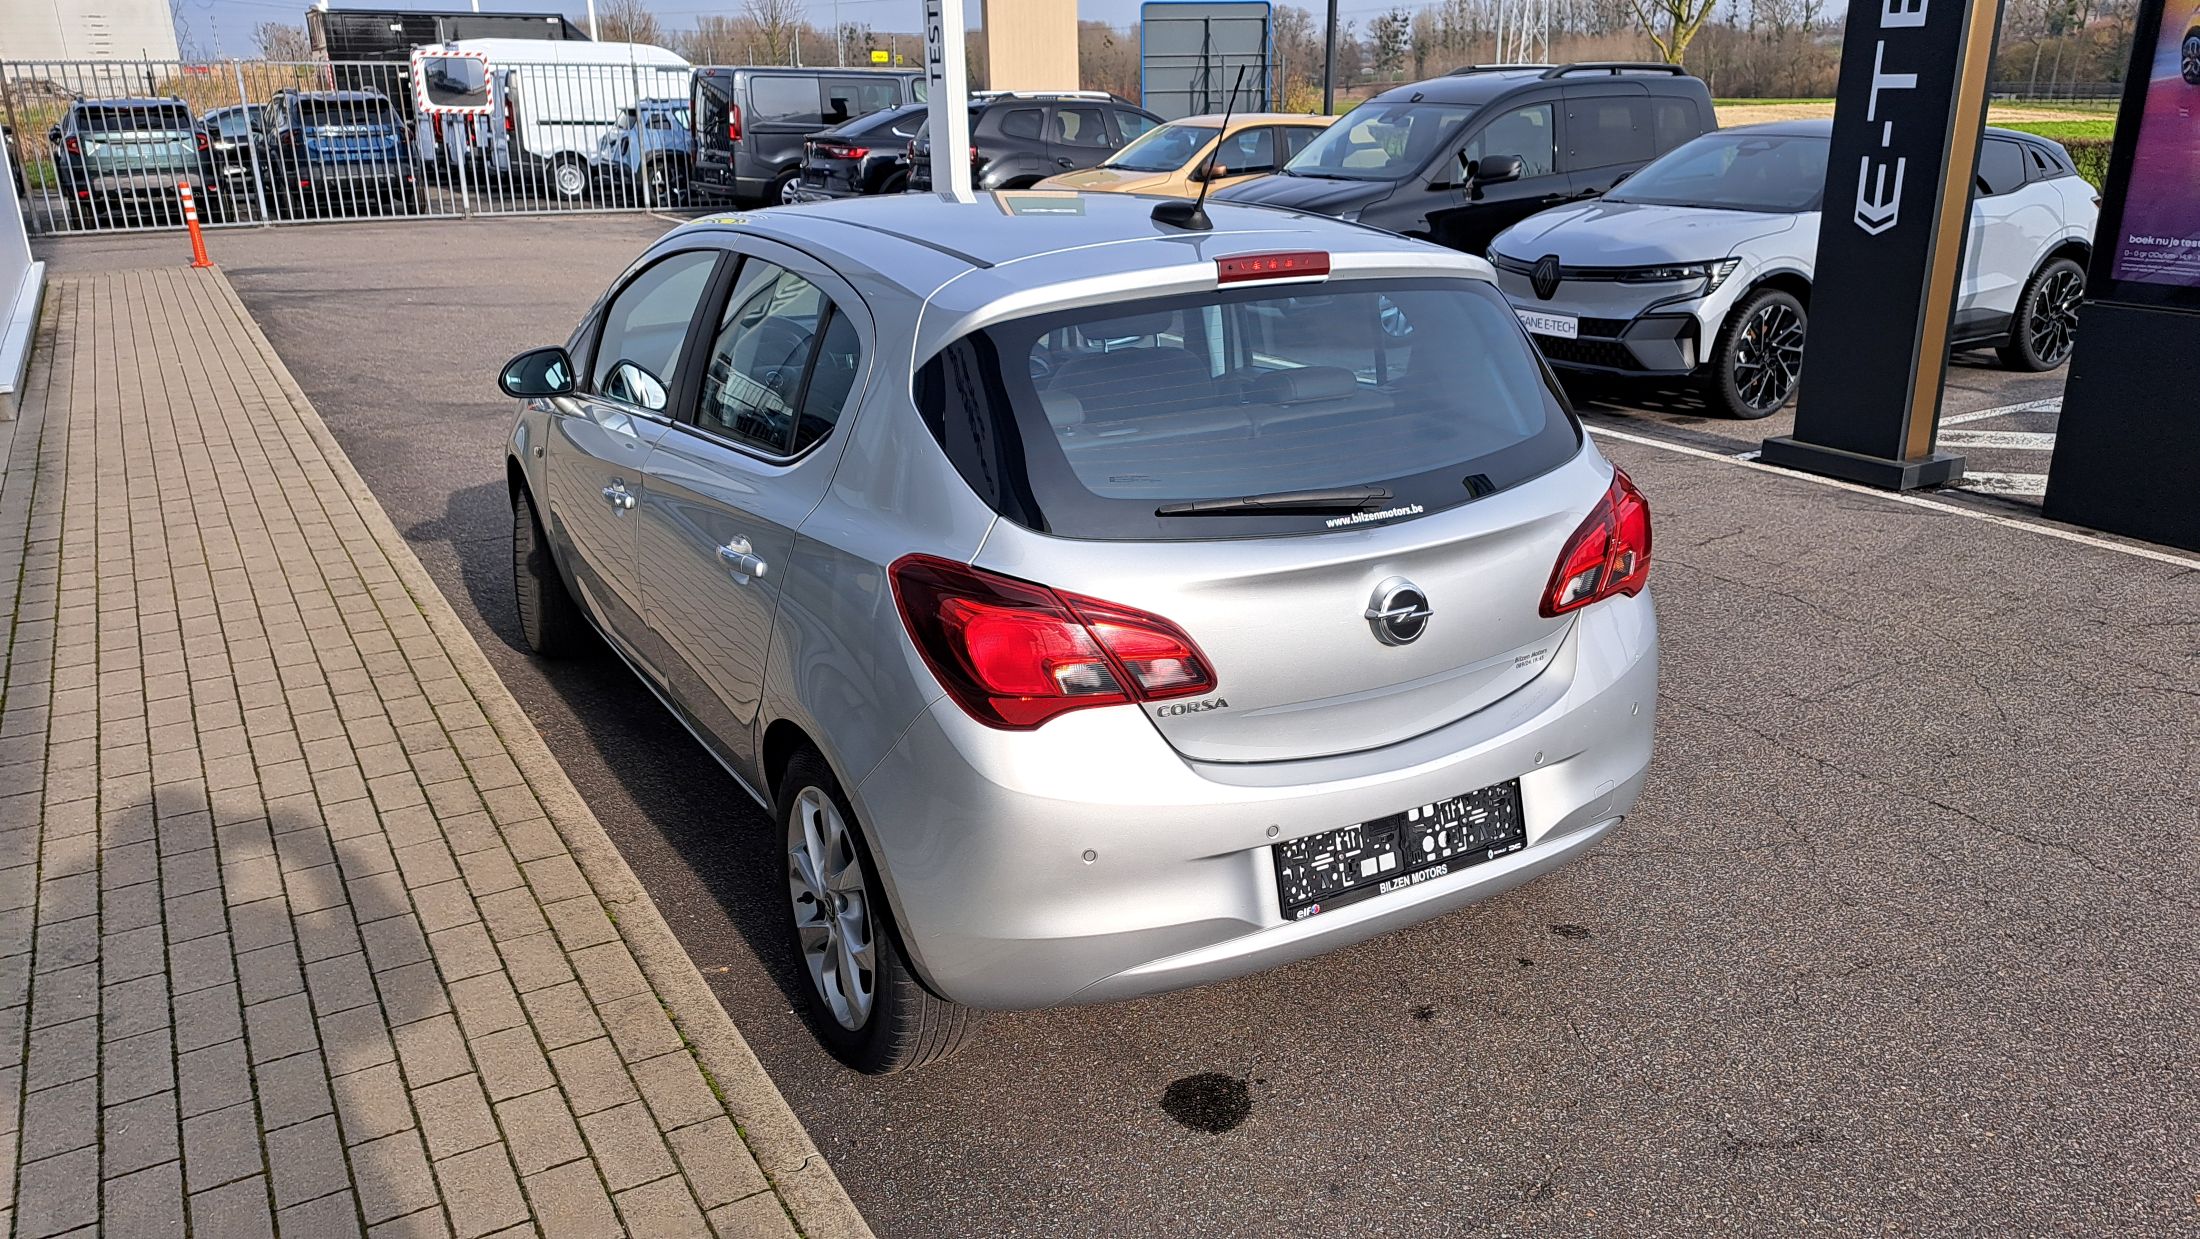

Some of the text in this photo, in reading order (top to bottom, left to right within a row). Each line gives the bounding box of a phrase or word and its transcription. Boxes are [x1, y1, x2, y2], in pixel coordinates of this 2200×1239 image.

[927, 0, 942, 87] TEST
[2129, 235, 2154, 244] boek
[2168, 236, 2180, 248] je
[1520, 314, 1576, 333] GANE E-TECH
[1326, 503, 1424, 528] www.bilzenmotors.be
[1157, 697, 1229, 718] CORSA
[1380, 863, 1448, 894] BILZEN MOTORS
[1296, 905, 1313, 919] elf
